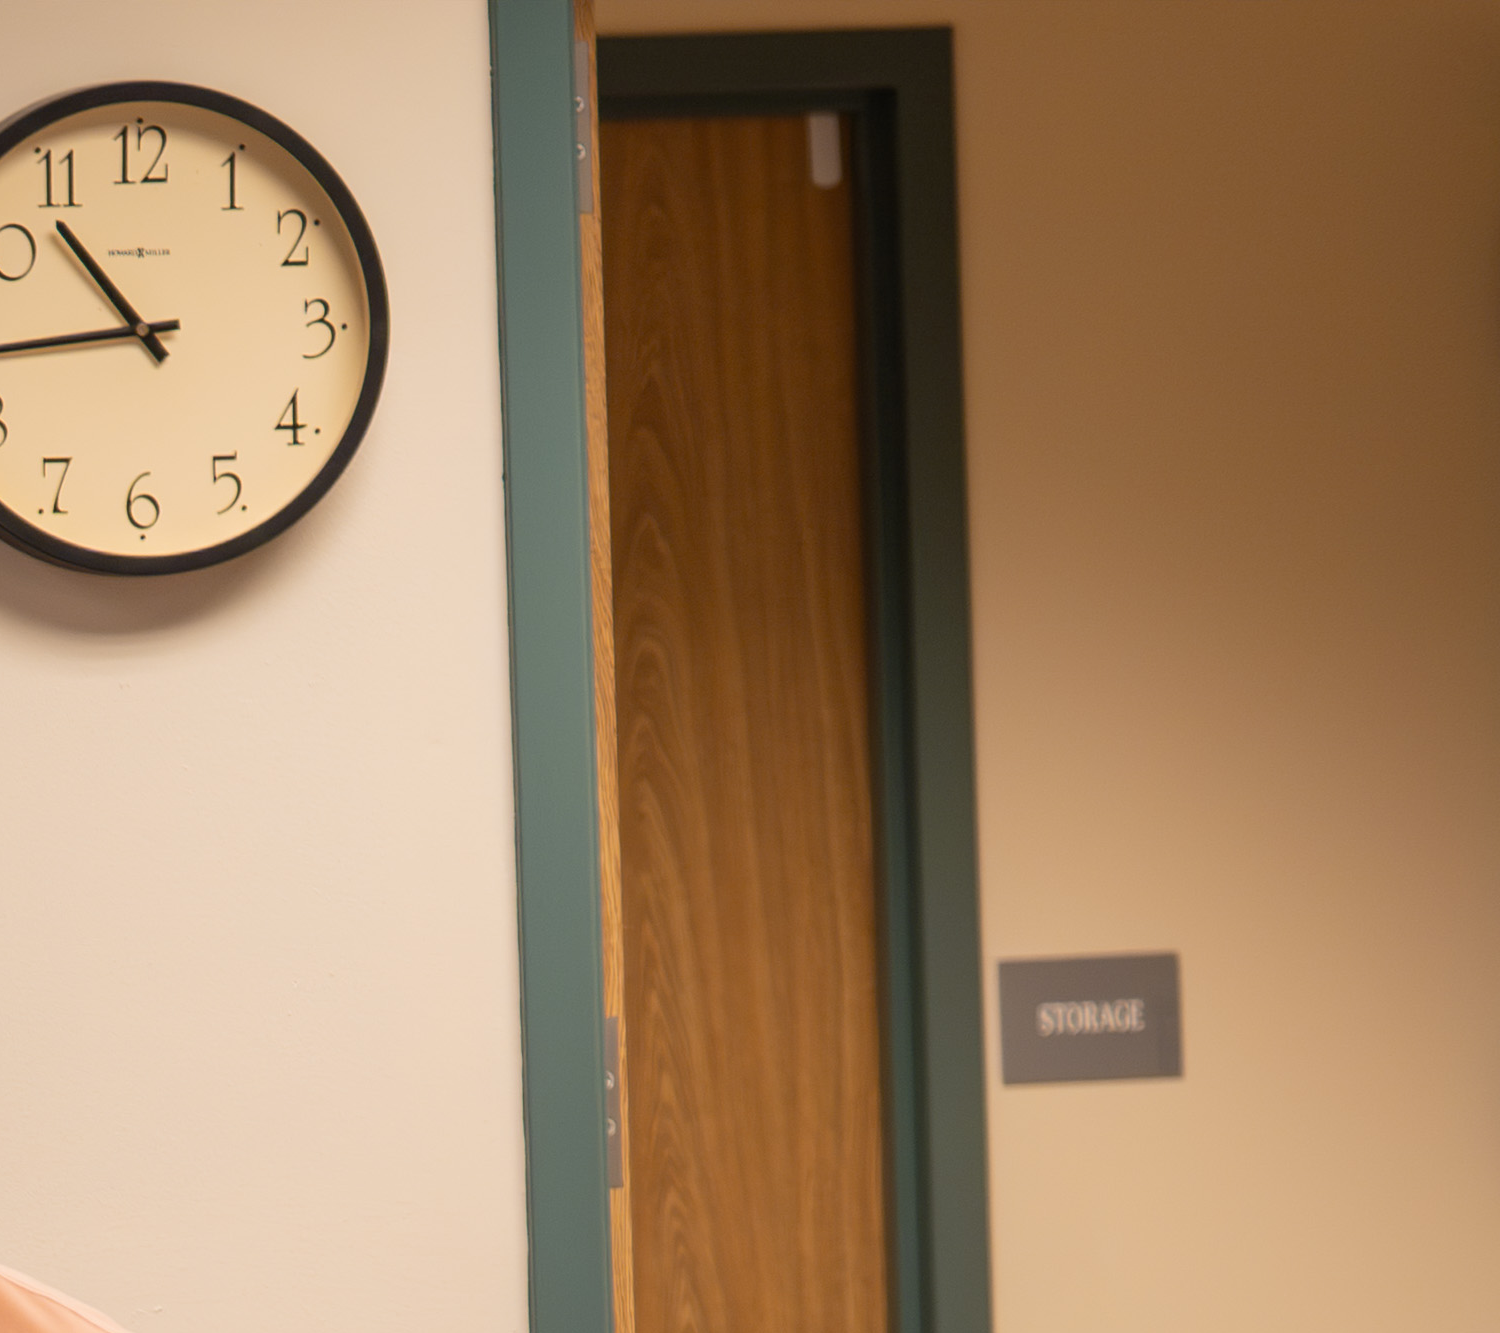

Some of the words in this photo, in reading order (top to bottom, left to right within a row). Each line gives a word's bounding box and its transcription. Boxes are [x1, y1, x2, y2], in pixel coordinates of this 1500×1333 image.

[37, 149, 83, 209] 11
[113, 124, 170, 186] 12
[220, 151, 245, 212] 1
[276, 209, 311, 267] 2
[303, 298, 337, 360] 3
[274, 388, 309, 447] 4
[42, 457, 74, 515] 7
[126, 471, 162, 530] 6
[212, 452, 244, 516] 5
[1036, 999, 1146, 1037] STORAGE
